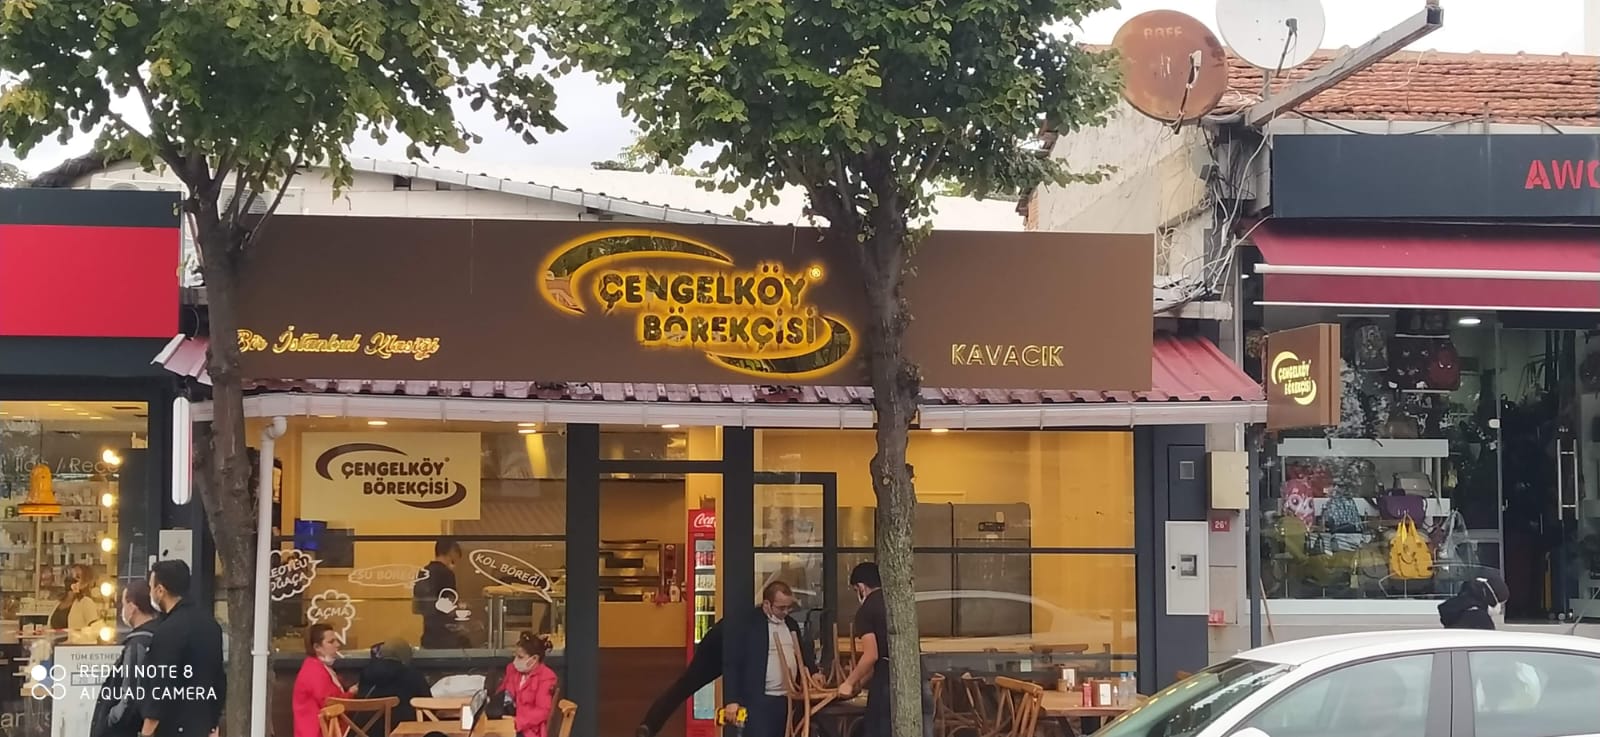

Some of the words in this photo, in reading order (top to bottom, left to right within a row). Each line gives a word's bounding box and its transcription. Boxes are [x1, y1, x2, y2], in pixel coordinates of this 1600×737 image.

[599, 264, 806, 312] ÇENGELKÖY
[643, 305, 817, 350] BÖREKÇİSİ
[272, 325, 361, 354] İstanbul
[364, 331, 440, 361] Klasiği
[951, 343, 1065, 367] KAVACIK
[341, 457, 445, 480] ÇENGELKÖY
[363, 477, 449, 498] BÖREKÇİSİ
[475, 553, 497, 569] KOL
[314, 607, 350, 620] AÇMA
